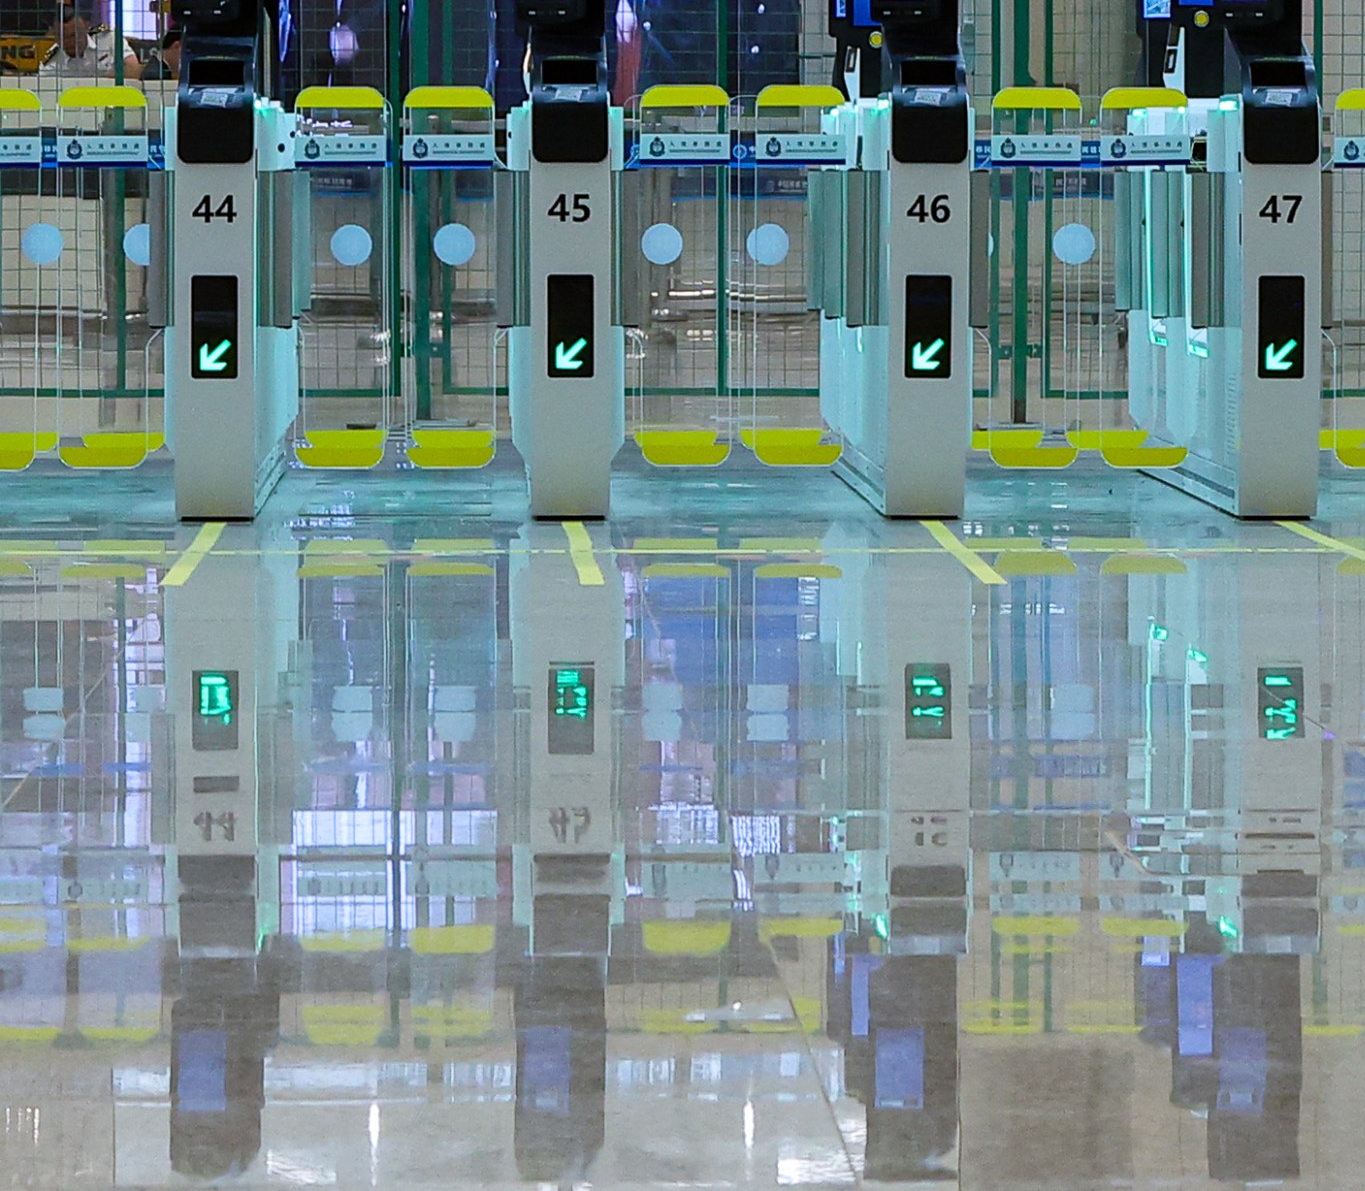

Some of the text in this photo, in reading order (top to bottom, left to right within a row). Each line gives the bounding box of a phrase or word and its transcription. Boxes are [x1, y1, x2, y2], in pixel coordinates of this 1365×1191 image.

[191, 194, 238, 224] 44
[547, 193, 591, 223] 45
[906, 194, 951, 224] 46
[1258, 194, 1303, 224] 47
